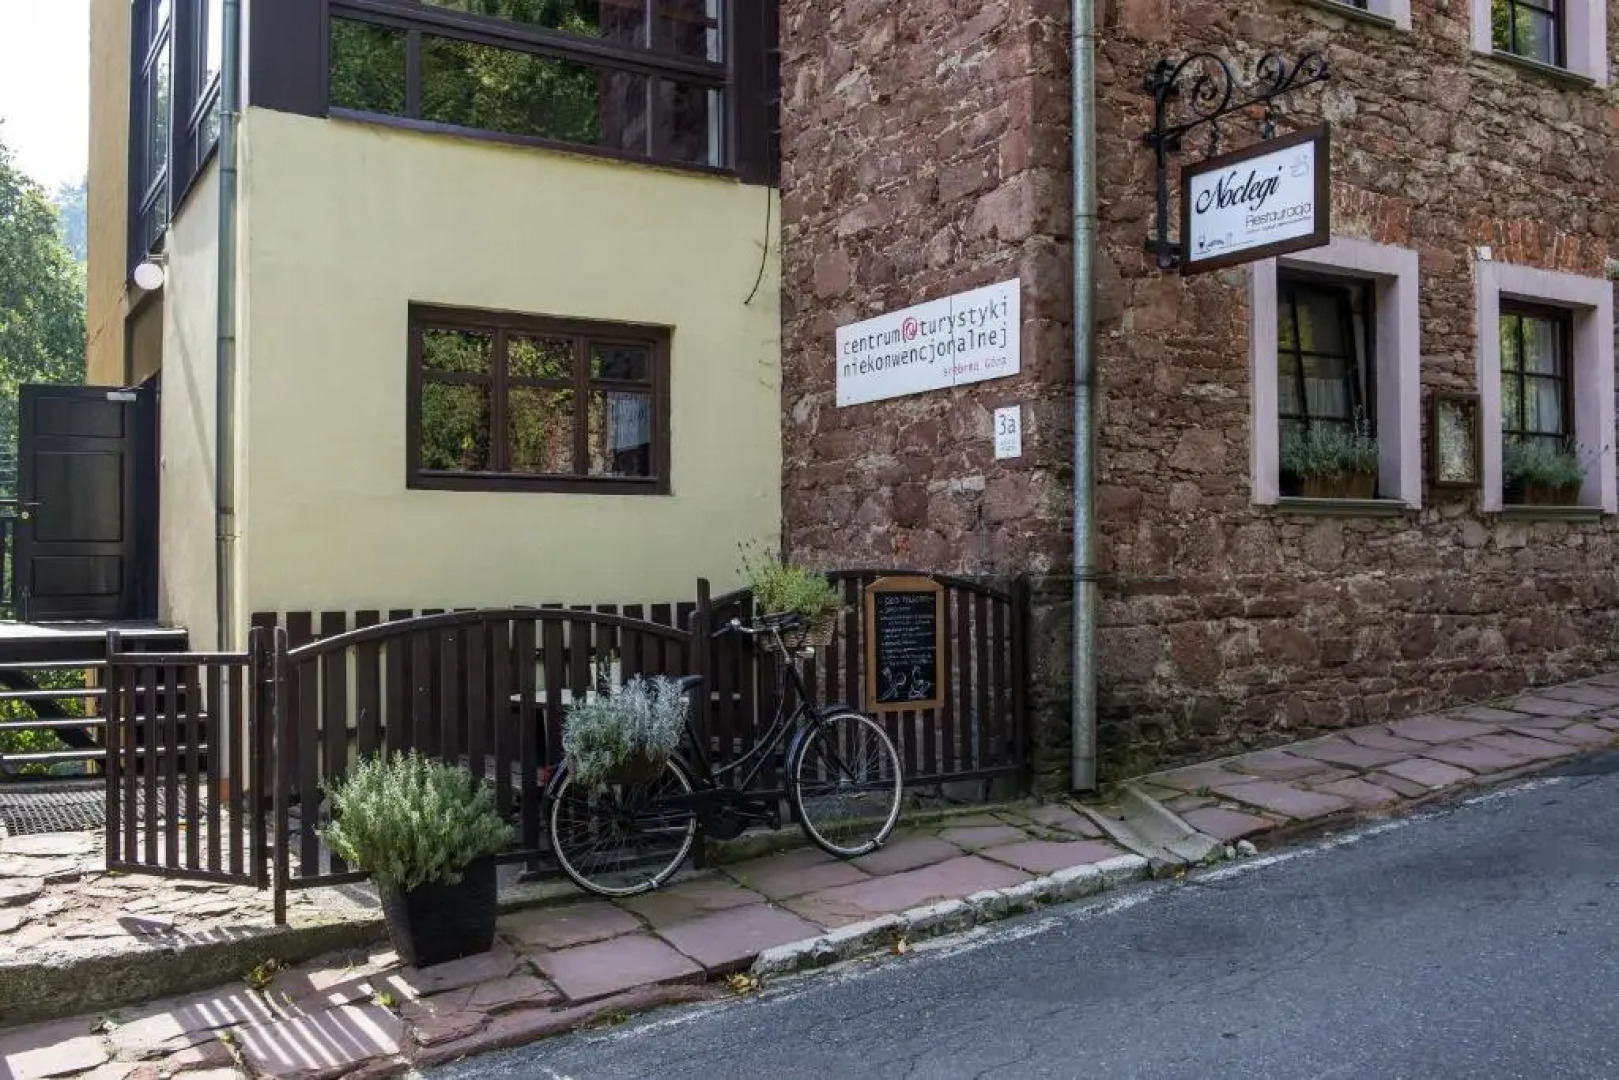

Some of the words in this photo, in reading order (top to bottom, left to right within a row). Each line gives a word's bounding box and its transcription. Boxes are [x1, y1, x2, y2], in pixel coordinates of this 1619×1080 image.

[1196, 166, 1282, 214] Noclegi
[843, 321, 1006, 378] niekonwencjonalnej
[998, 413, 1016, 436] 3a
